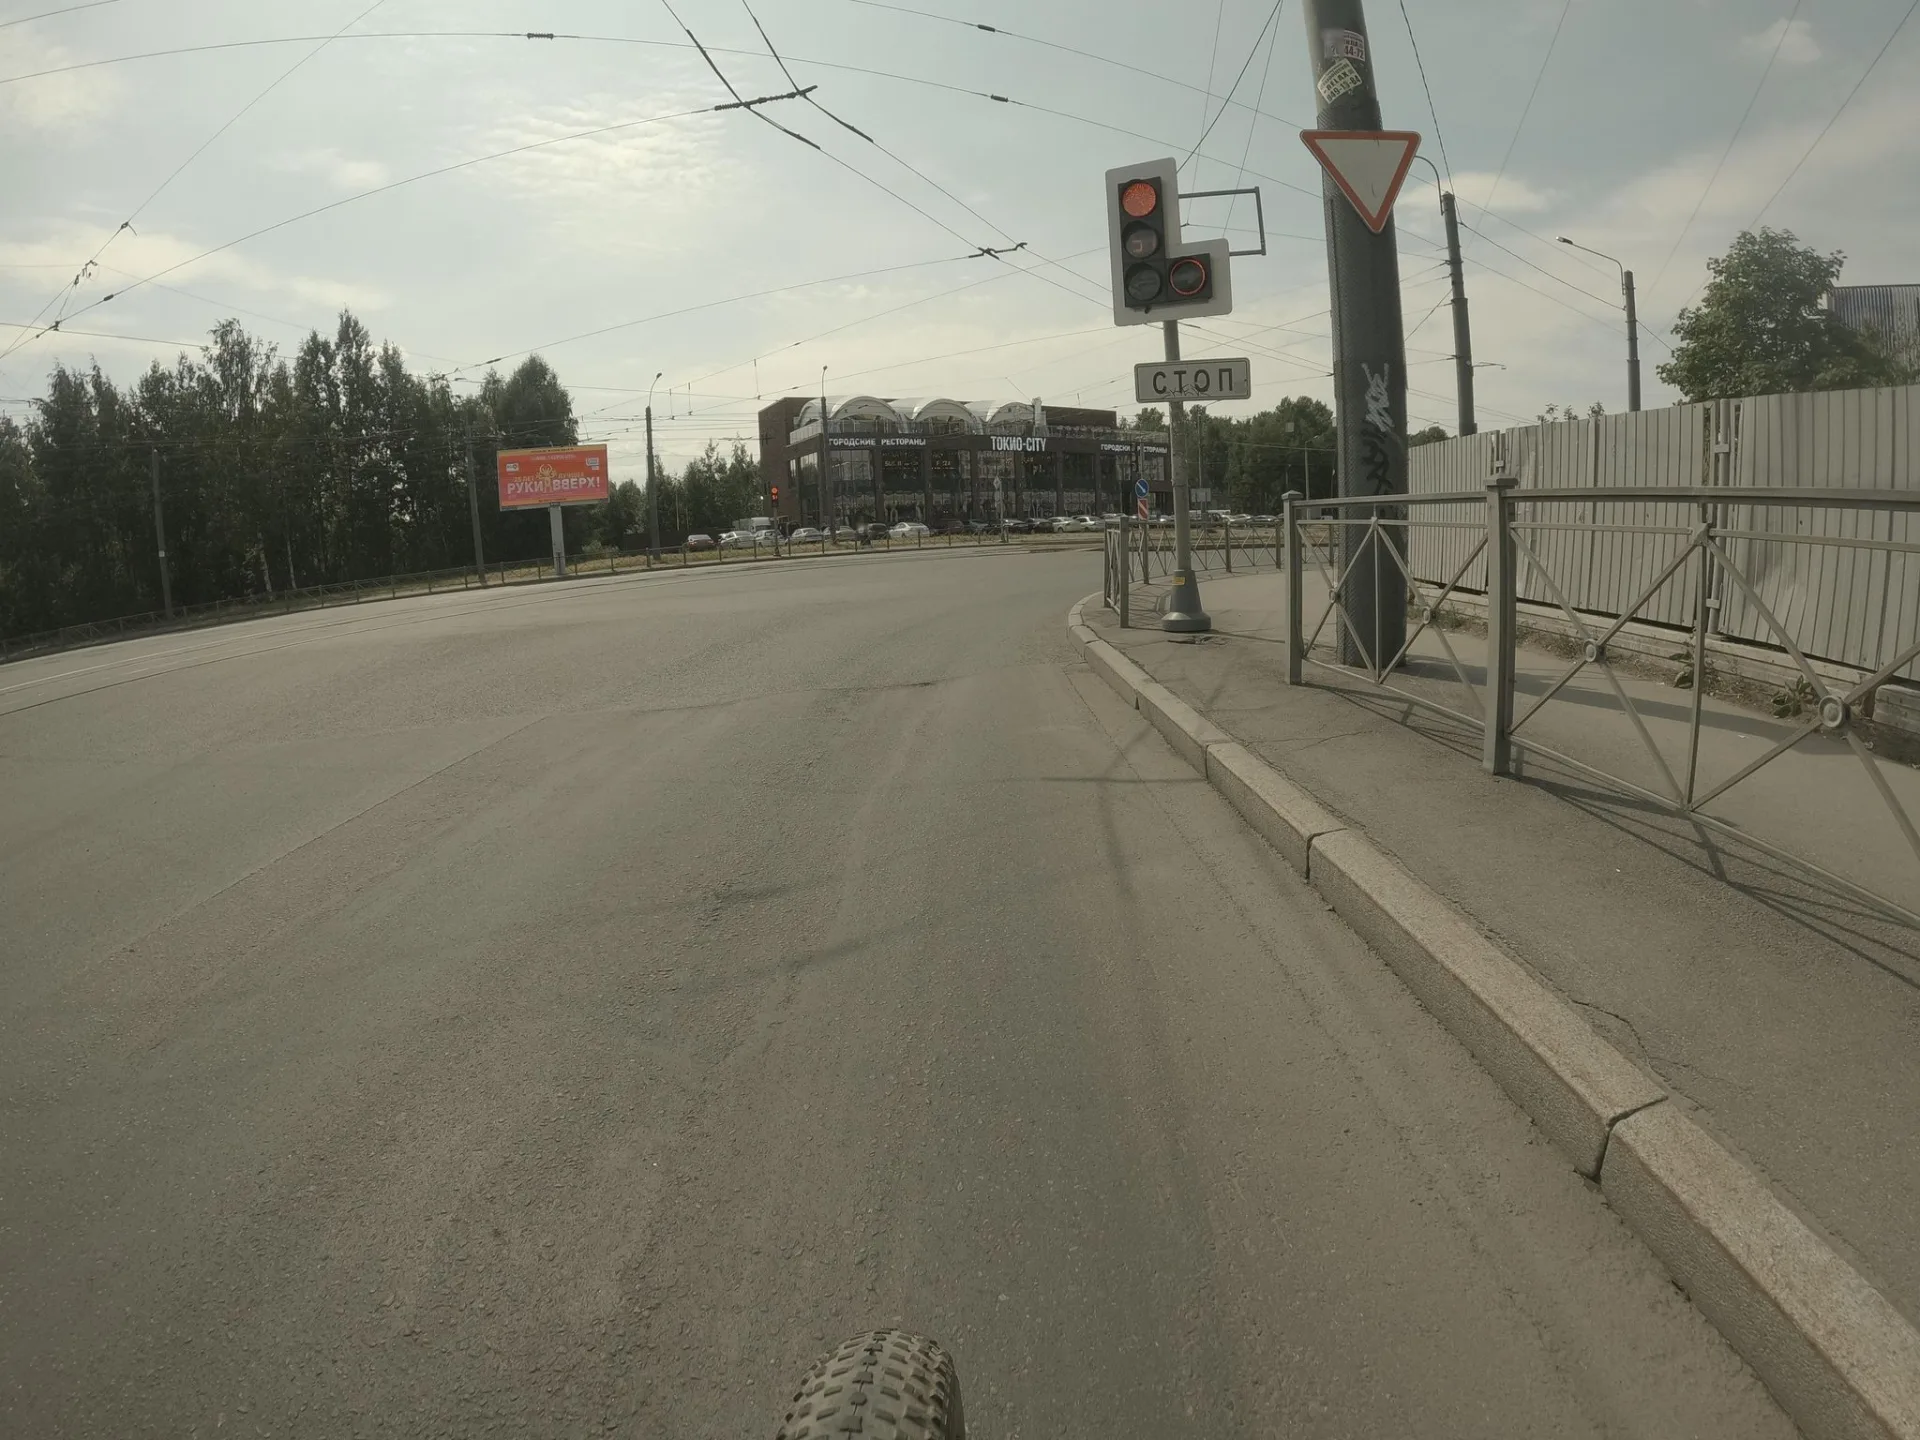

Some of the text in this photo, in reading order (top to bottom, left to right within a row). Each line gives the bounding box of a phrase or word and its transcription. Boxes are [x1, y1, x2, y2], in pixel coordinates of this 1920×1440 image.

[1152, 368, 1233, 394] СТОП
[828, 438, 927, 447] ГОРОДСКИЕ РЕСТОРАНЫ
[1100, 443, 1168, 454] ГОРОДСКИ РСТОРАНЫ
[507, 476, 600, 494] РУКИ ВВЕРХ!
